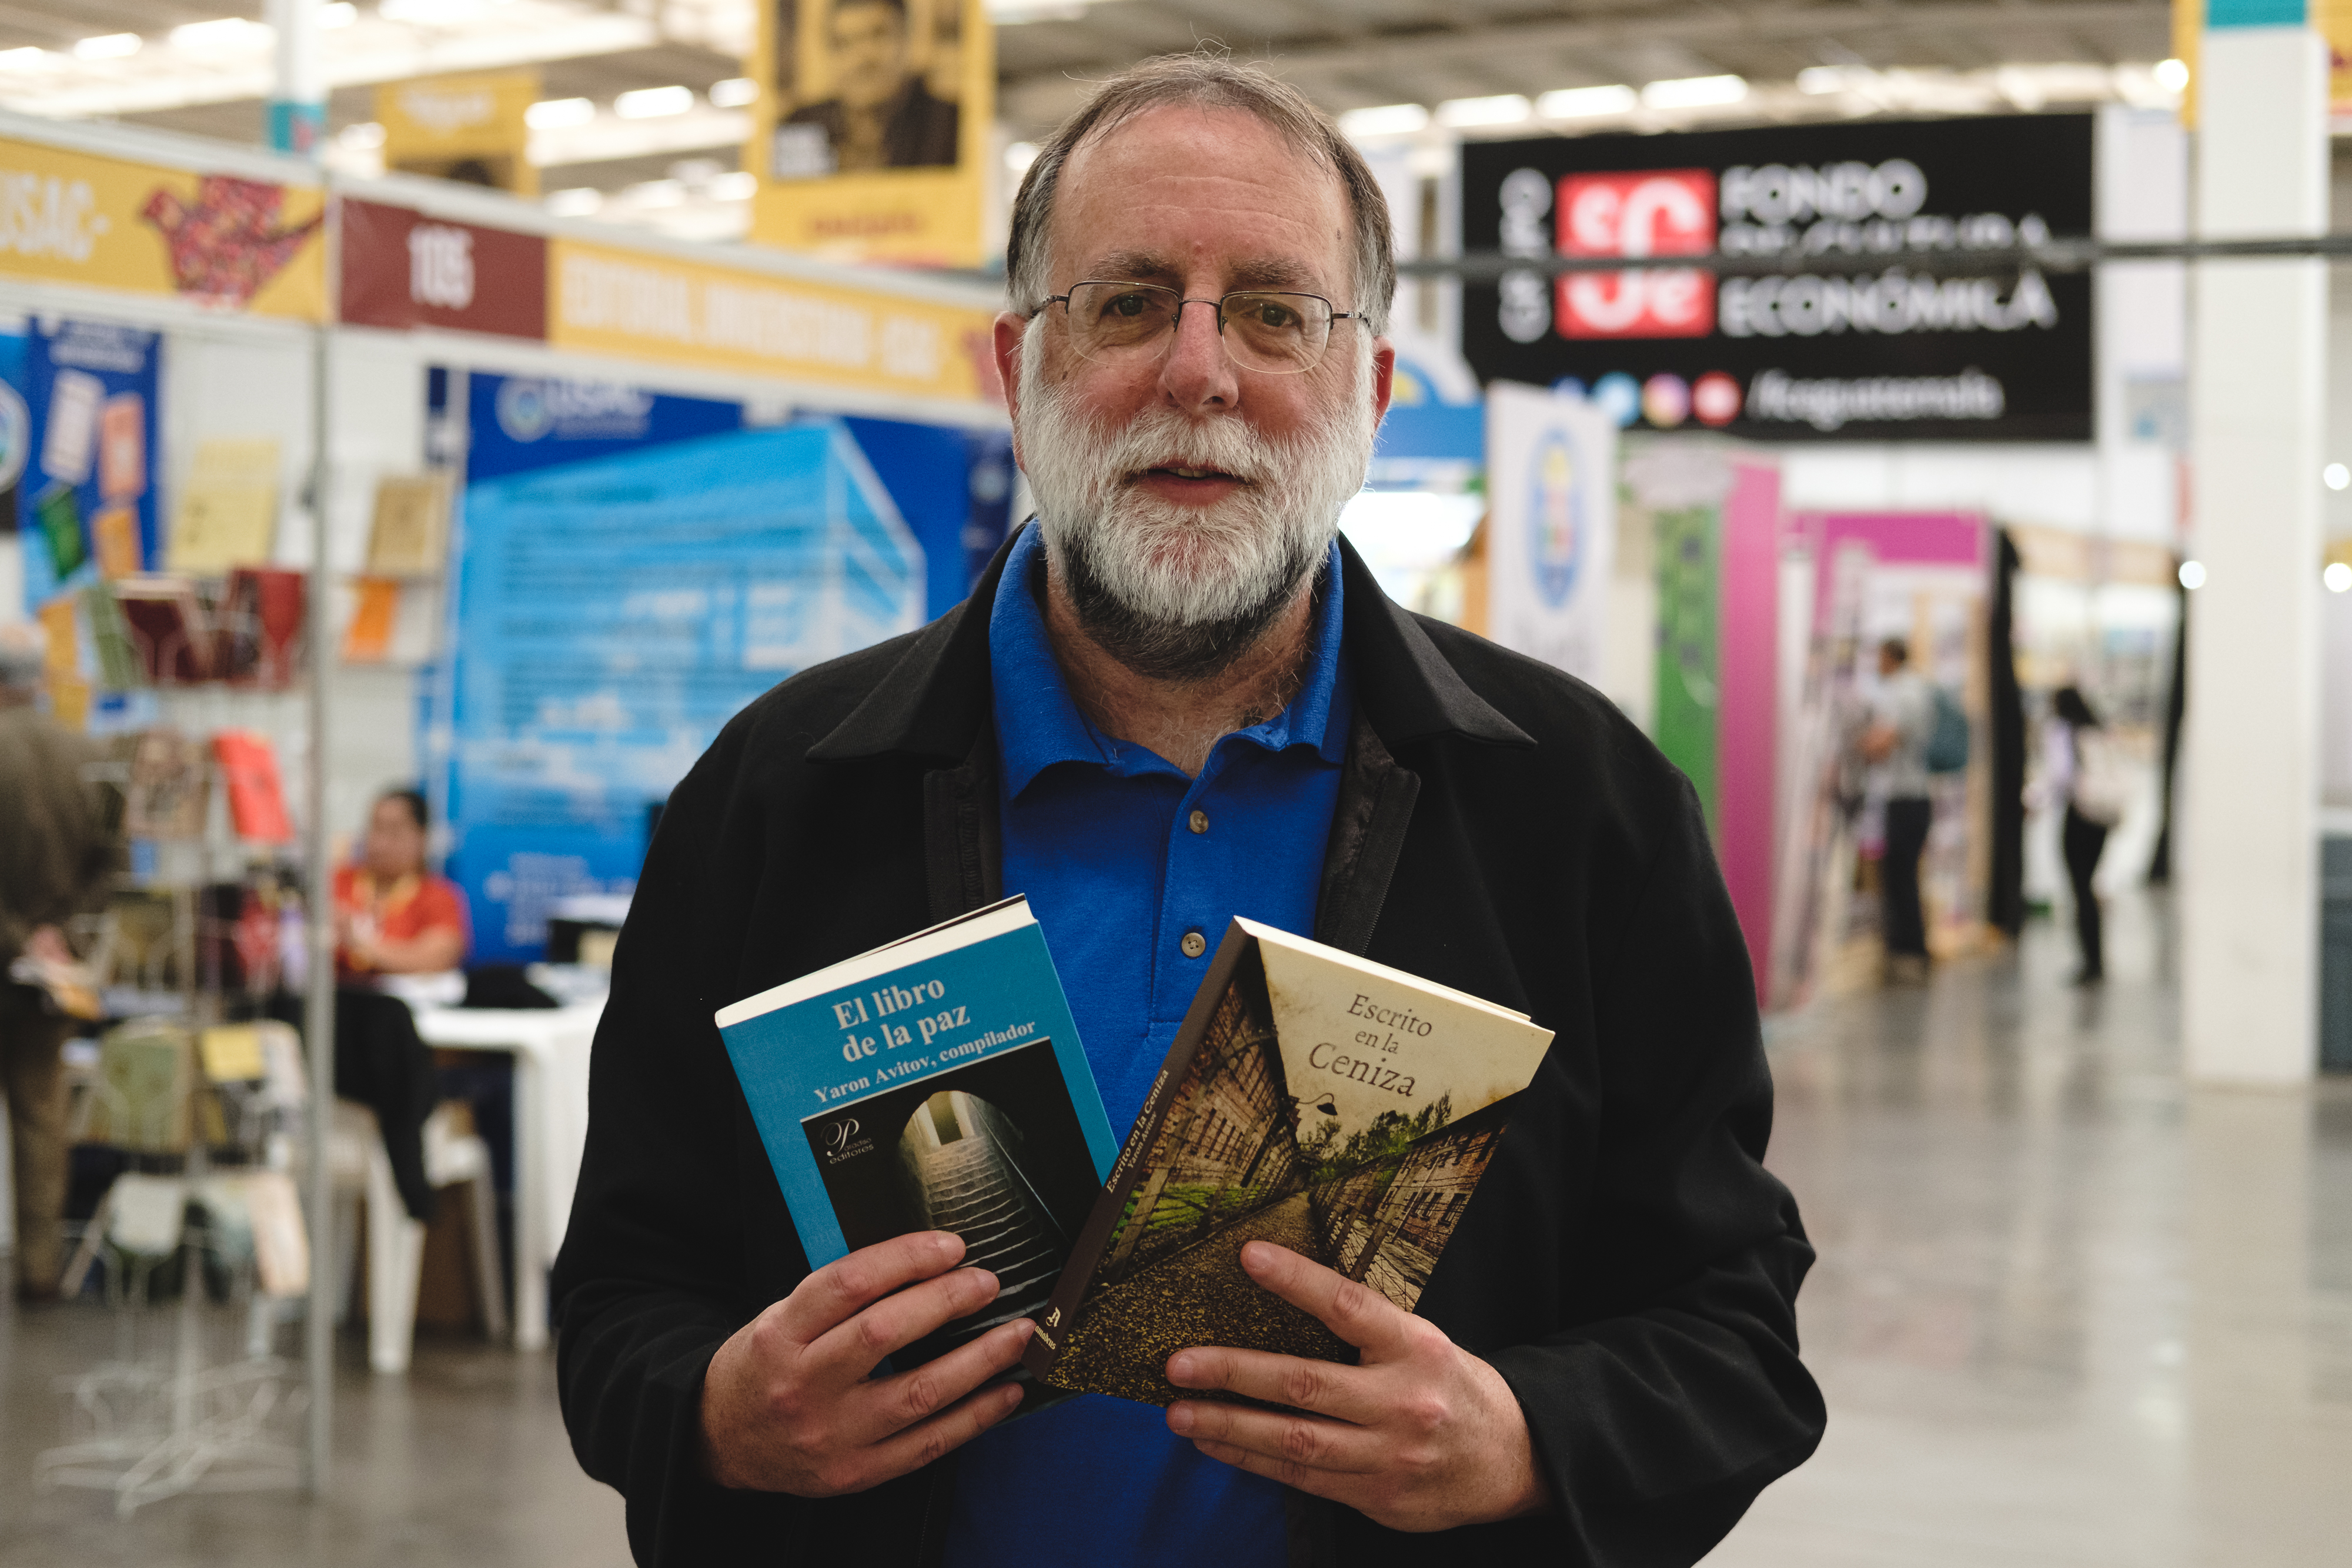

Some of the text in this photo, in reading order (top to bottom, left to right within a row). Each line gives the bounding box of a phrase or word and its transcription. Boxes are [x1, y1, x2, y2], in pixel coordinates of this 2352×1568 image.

[1721, 159, 1927, 223] FONDO
[831, 979, 946, 1030] El libro
[1347, 993, 1432, 1037] Escrito
[842, 1005, 971, 1062] de la paz
[1354, 1030, 1399, 1054] en la
[814, 1021, 1035, 1103] Yaron Avitov, compilador
[1308, 1042, 1416, 1097] Ceniza
[829, 1144, 874, 1164] editores
[1107, 1069, 1169, 1193] Escrito en la Ceniza
[1127, 1141, 1144, 1168] Yaron
